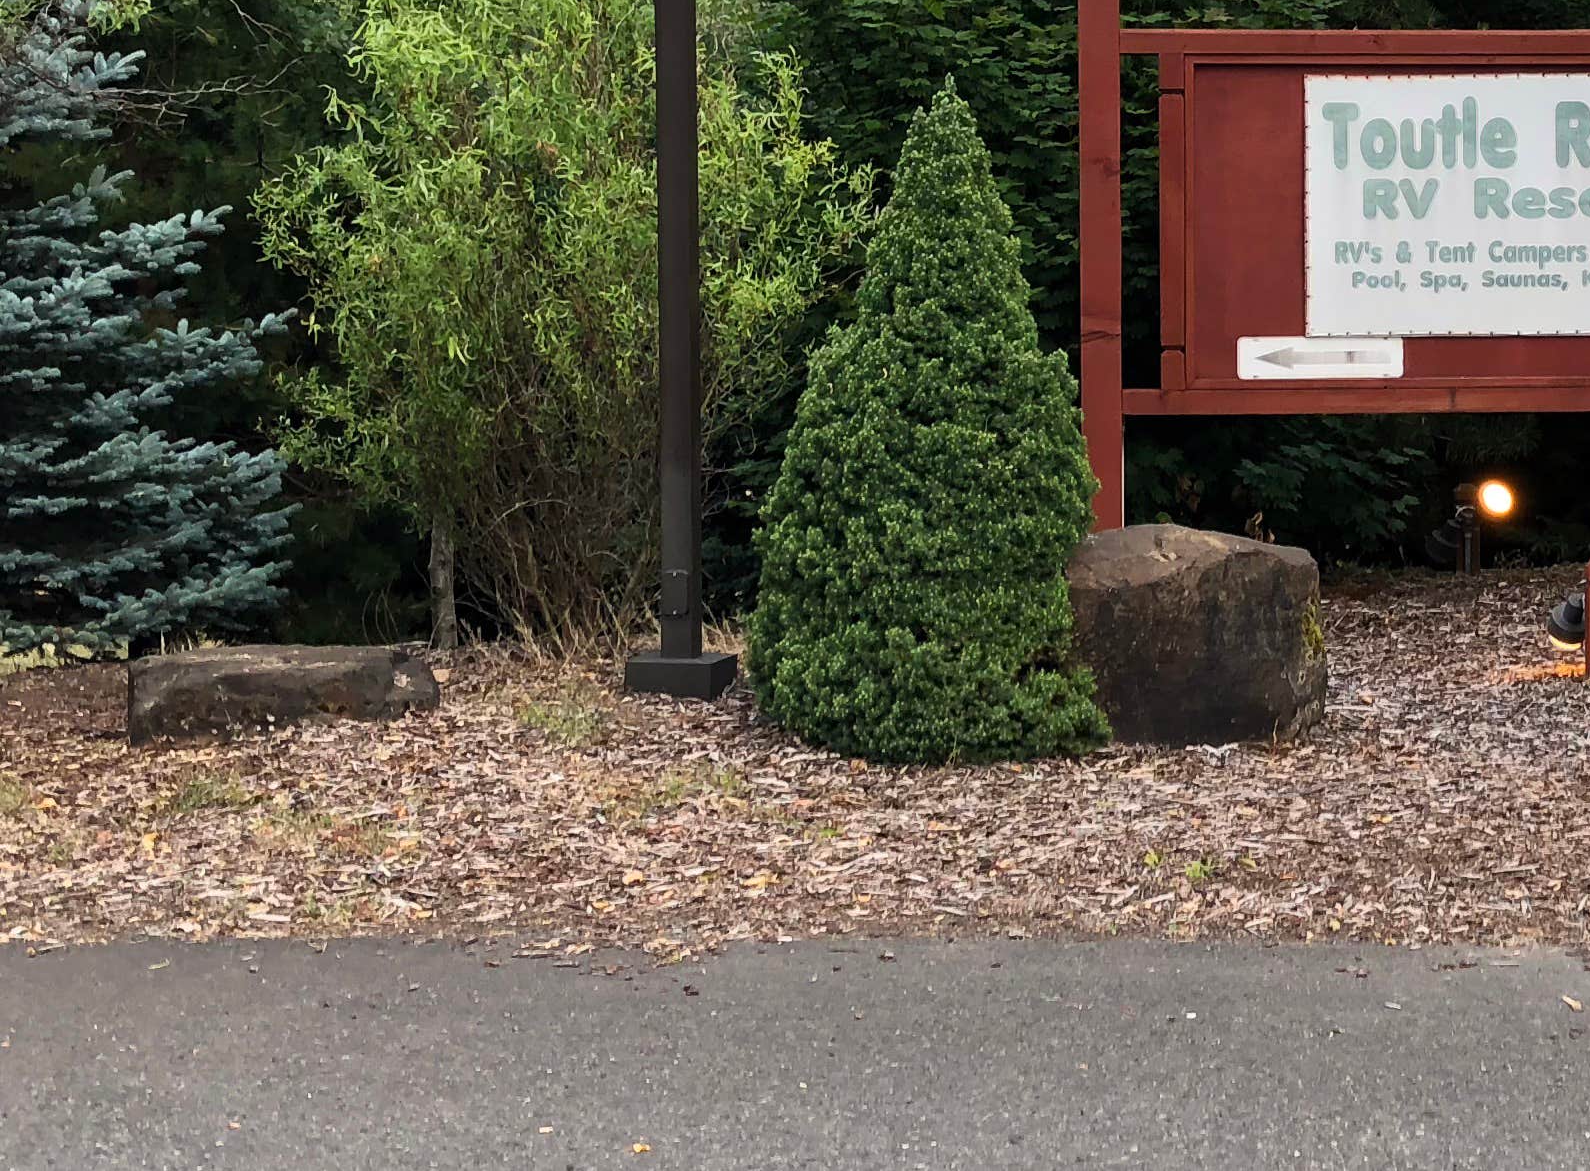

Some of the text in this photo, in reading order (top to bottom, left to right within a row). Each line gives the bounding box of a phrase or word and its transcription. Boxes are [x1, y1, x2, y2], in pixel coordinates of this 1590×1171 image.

[1321, 95, 1518, 171] Toutle
[1362, 177, 1439, 222] RV
[1334, 240, 1383, 265] RV's
[1395, 240, 1412, 264] &
[1424, 240, 1478, 264] Tent
[1487, 240, 1589, 271] Campers
[1351, 269, 1407, 293] Pool,
[1419, 270, 1469, 294] Spa,
[1481, 269, 1569, 292] Saunas,
